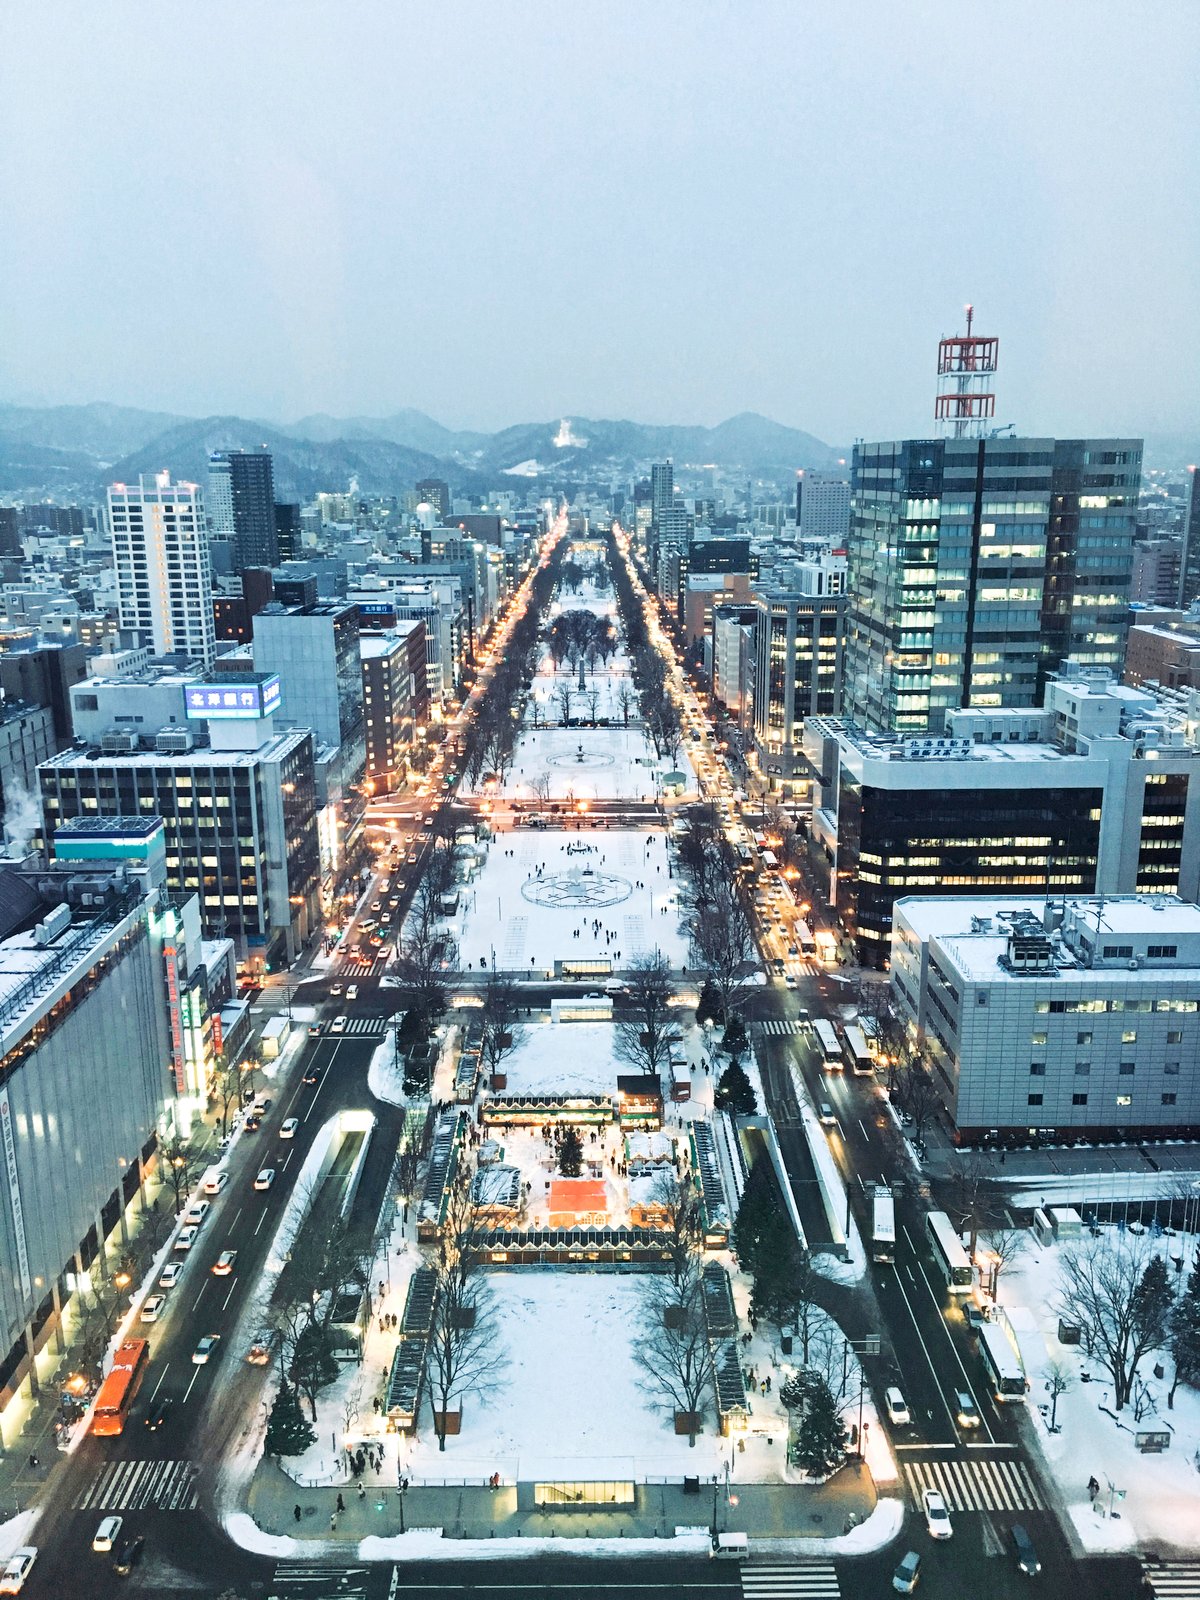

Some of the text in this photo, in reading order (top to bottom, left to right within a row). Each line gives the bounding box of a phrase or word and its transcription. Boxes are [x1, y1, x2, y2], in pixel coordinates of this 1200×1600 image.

[191, 692, 254, 706] 北洋銀行
[910, 739, 970, 747] 北海道新聞
